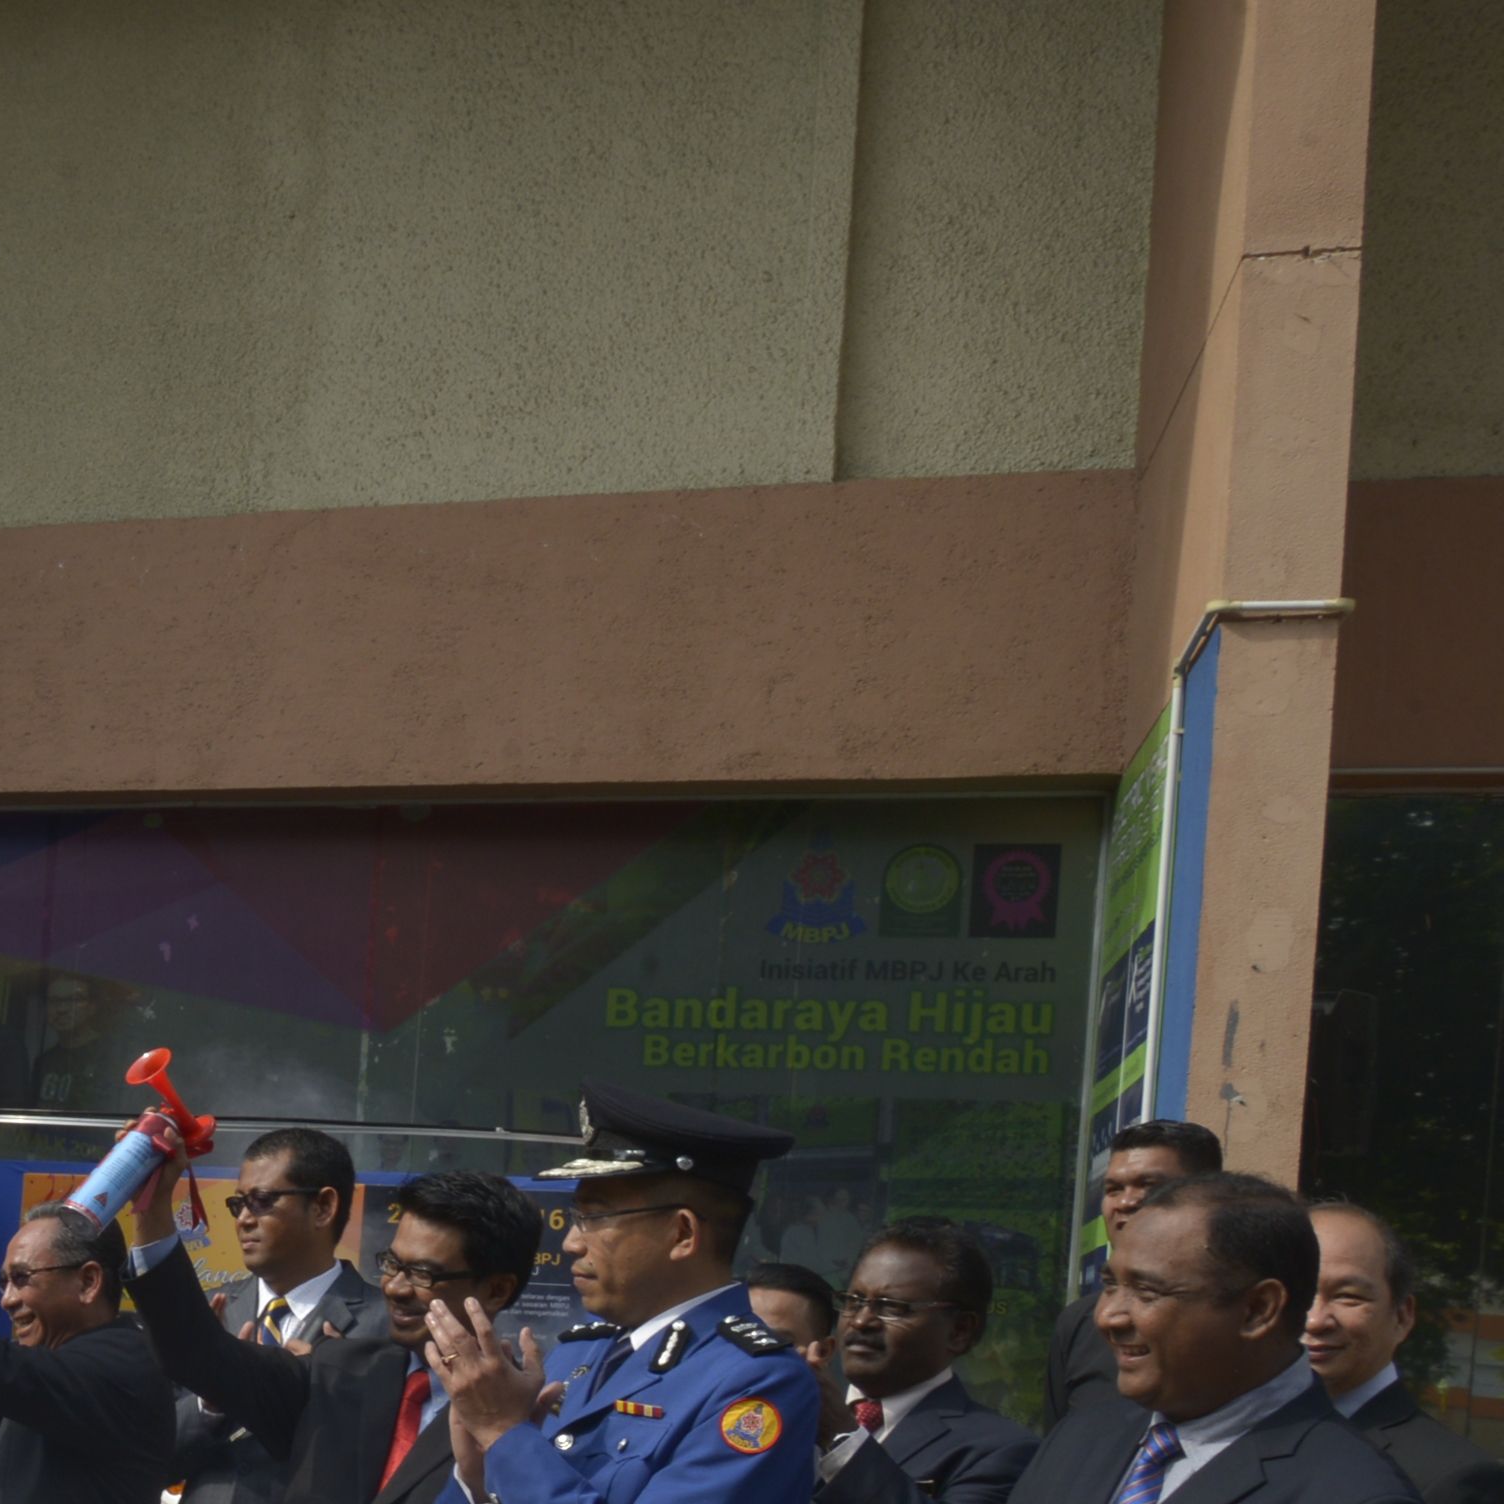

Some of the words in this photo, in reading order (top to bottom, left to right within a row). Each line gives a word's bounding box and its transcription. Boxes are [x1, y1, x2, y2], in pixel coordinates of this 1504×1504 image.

[780, 921, 851, 945] MBPJ
[760, 959, 858, 982] Inisiatif
[865, 960, 944, 983] MBPJ
[953, 961, 987, 983] Ke
[994, 961, 1057, 984] Arah
[604, 986, 889, 1042] Bandaraya
[908, 989, 1055, 1045] Hijau
[642, 1034, 866, 1072] Berkarbon
[880, 1037, 1050, 1076] Rendah
[533, 1252, 562, 1267] BPJ
